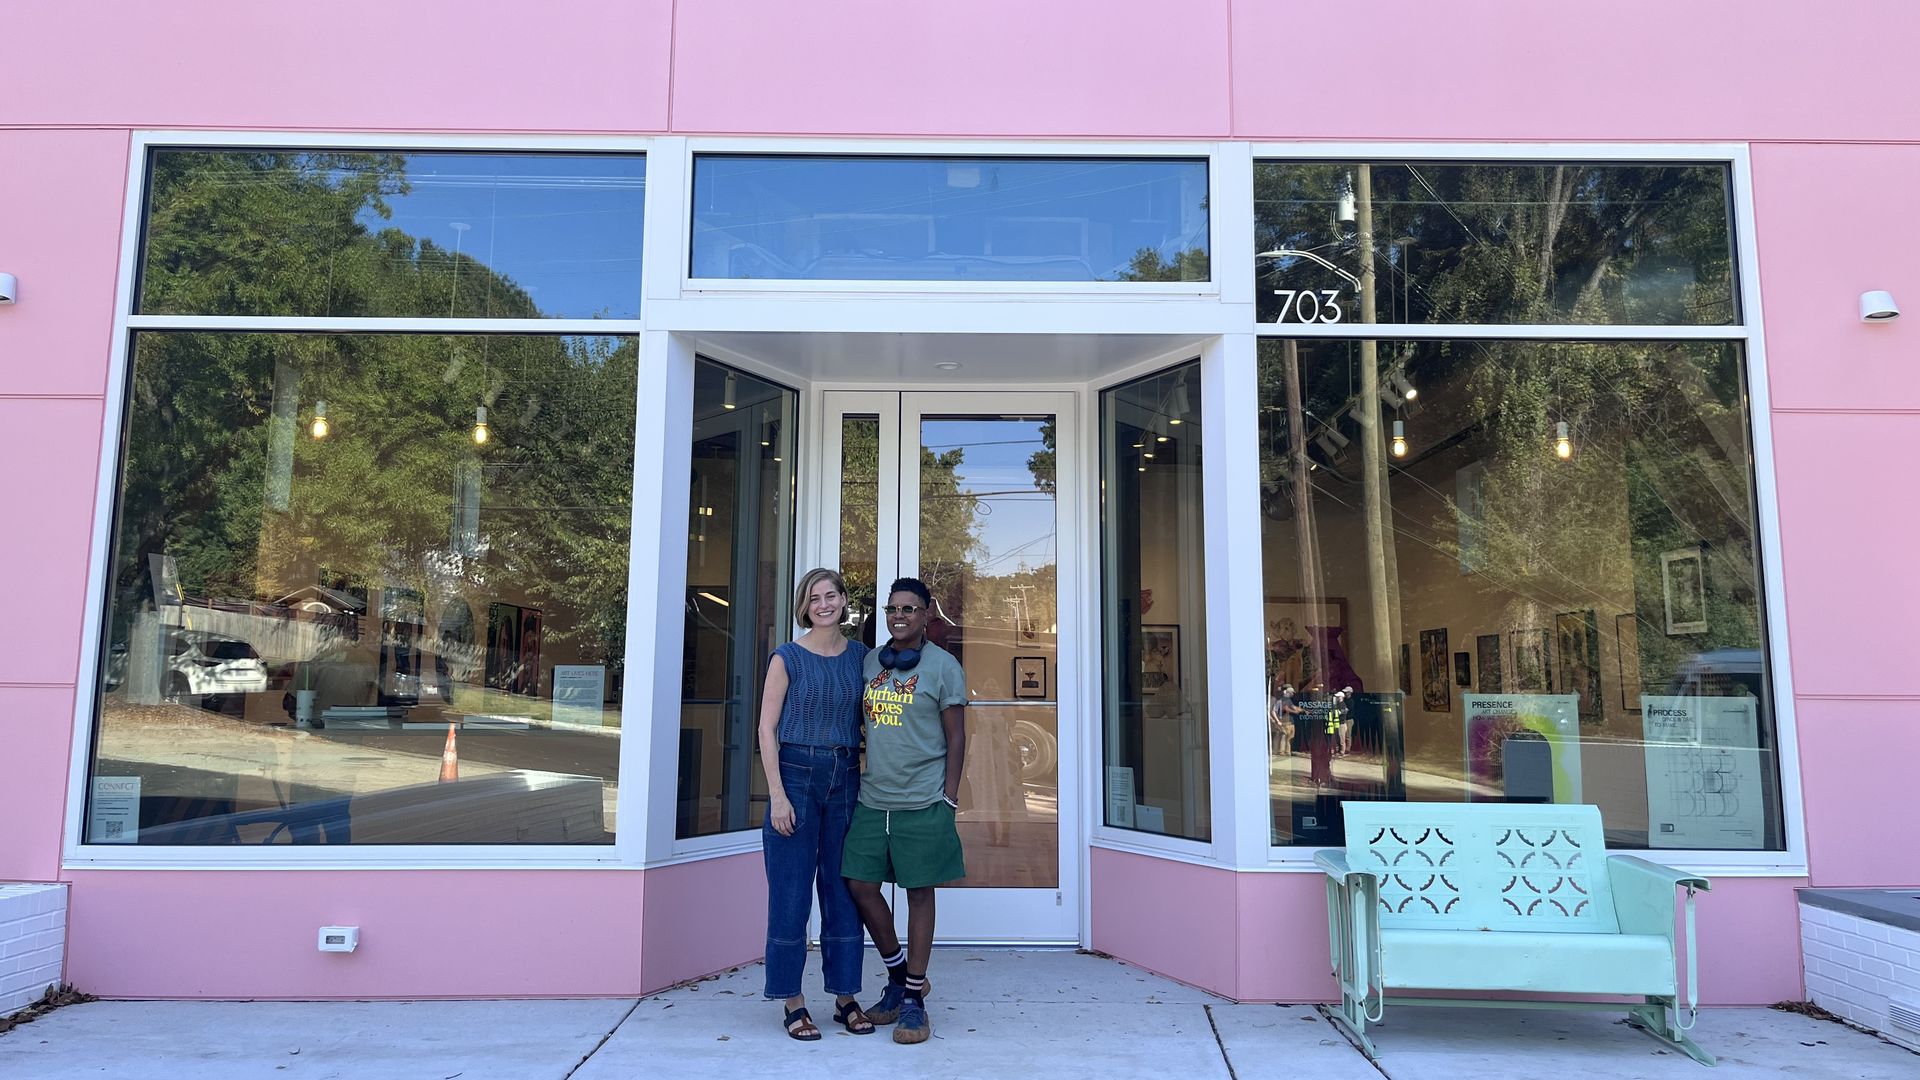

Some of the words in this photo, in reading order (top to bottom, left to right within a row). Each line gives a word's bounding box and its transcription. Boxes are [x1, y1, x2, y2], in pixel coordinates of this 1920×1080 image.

[1274, 289, 1342, 324] 703
[872, 692, 903, 715] loves
[1298, 701, 1332, 709] PASSAGE
[1471, 701, 1513, 709] PRESENCE
[1652, 709, 1687, 717] PROCESS
[873, 713, 903, 729] you.
[98, 782, 135, 790] CONNECT
